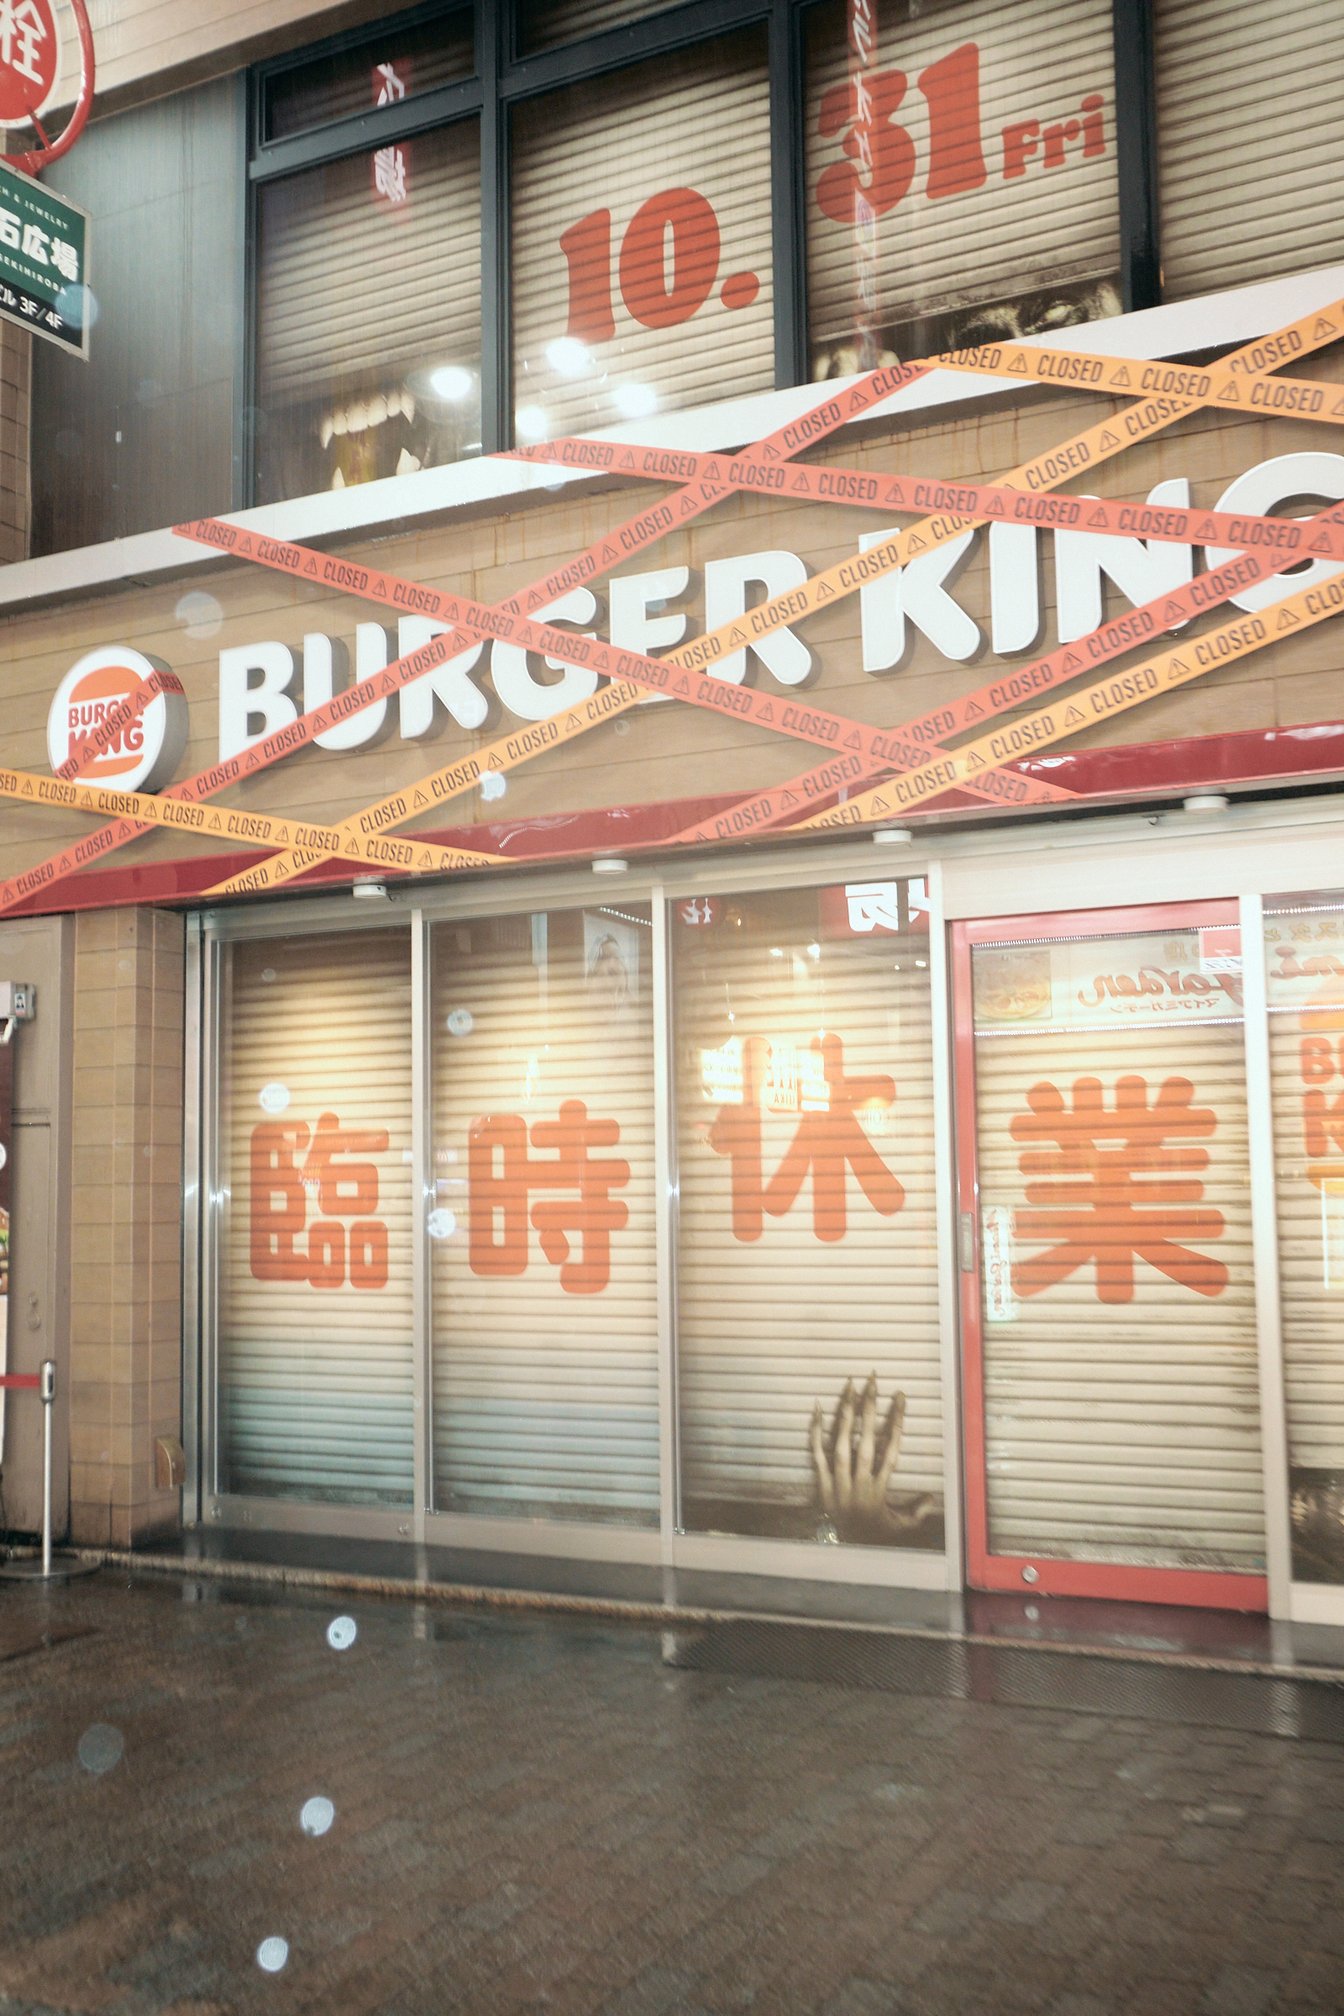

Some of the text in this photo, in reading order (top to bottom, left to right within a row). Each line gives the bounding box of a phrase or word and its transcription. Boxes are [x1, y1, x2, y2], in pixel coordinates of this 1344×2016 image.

[24, 200, 69, 231] JEWELRY
[559, 186, 760, 343] 10.
[815, 41, 988, 224] 31
[1001, 94, 1106, 180] Fri
[20, 296, 63, 330] 3F/4F
[938, 348, 1324, 412] CLOSED CLOSED CLOSED CLOSED
[562, 443, 614, 466] CLOSED
[643, 452, 697, 476] CLOSED
[728, 462, 785, 488] CLOSED
[819, 474, 878, 500] CLOSED
[914, 485, 977, 512] CLOSED
[1014, 497, 1080, 524] CLOSED
[1118, 509, 1188, 536] CLOSED
[1228, 520, 1301, 549] CLOSED
[16, 366, 924, 894] CLOSED CLOSED CLOSED CLOSED CLOSED CLOSED CLOSED CLOSED CLOSED CLOS
[196, 520, 237, 548] CLOSED
[257, 540, 300, 568] CLOSED
[323, 561, 368, 590] CLOSED
[393, 584, 440, 614] CLOSED
[466, 607, 514, 637] CLOSED
[540, 631, 590, 662] CLOSED
[617, 655, 670, 687] CLOSED
[697, 681, 752, 713] CLOSED
[781, 707, 840, 742] CLOSED
[870, 736, 931, 769] CLOSED
[219, 452, 1344, 766] BURGER KING
[225, 869, 269, 895] CLOSED
[292, 849, 322, 868] CLO
[360, 798, 407, 834] CLOSED
[431, 760, 480, 798] CLOSED
[507, 721, 559, 760] CLOSED
[586, 684, 638, 720] CLOSED
[752, 590, 808, 634] CLOSED
[839, 544, 898, 588] CLOSED
[931, 516, 973, 540] CLO
[1026, 442, 1090, 490] CLOSED
[1125, 399, 1192, 436] CLOSE
[1231, 331, 1302, 375] CLOSED
[56, 760, 79, 782] SED
[95, 704, 132, 747] CLOSED
[68, 696, 144, 729] BURG
[68, 719, 144, 758] KNG
[716, 558, 1261, 838] CLOSED CLOSED OSED CLOSED CLOSED CLOSED
[808, 578, 1344, 829] OSED CLOSED CLOSED CLOSED CLOSED CLO
[38, 781, 77, 803] CLOSED
[98, 793, 139, 815] CLOSED
[163, 801, 204, 826] CLOSED
[227, 815, 271, 839] CLOSED
[295, 828, 340, 851] CLOSED
[366, 839, 413, 865] CLOSED
